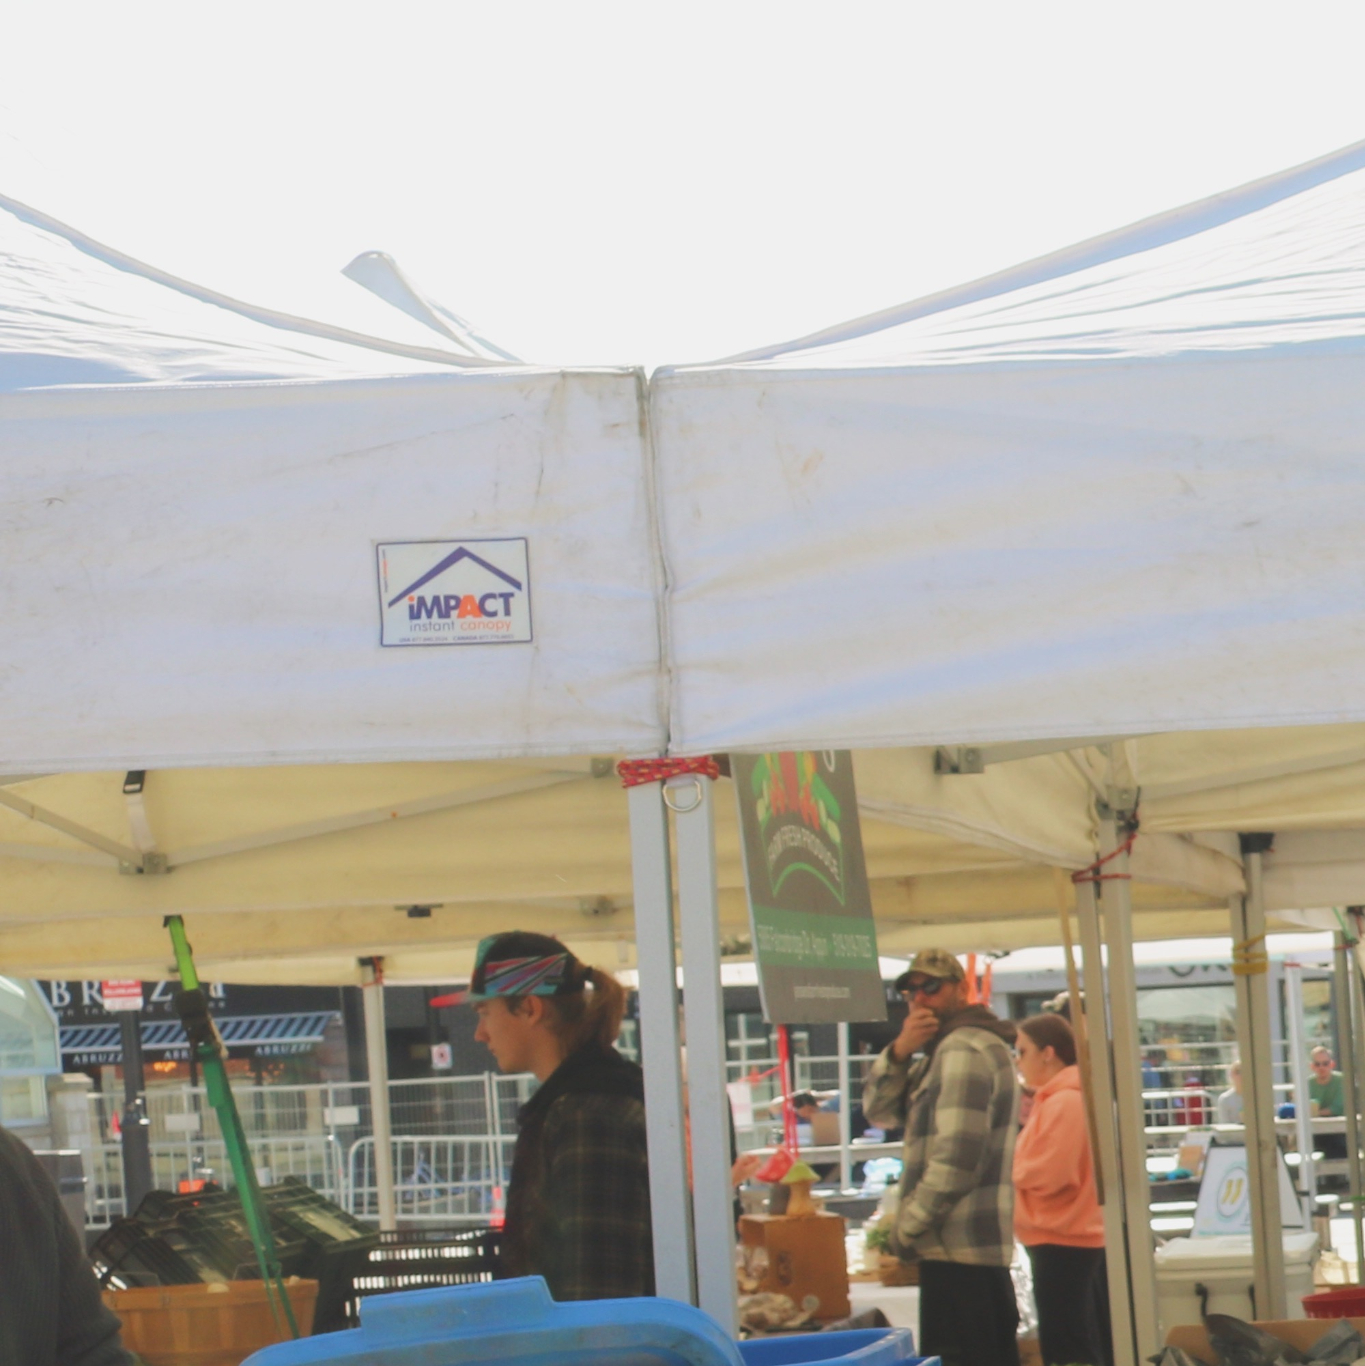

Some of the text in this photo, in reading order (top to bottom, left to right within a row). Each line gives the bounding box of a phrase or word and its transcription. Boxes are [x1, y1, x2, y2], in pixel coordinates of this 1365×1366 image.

[409, 618, 512, 634] instant canopy
[72, 1052, 123, 1065] ABRUZZ
